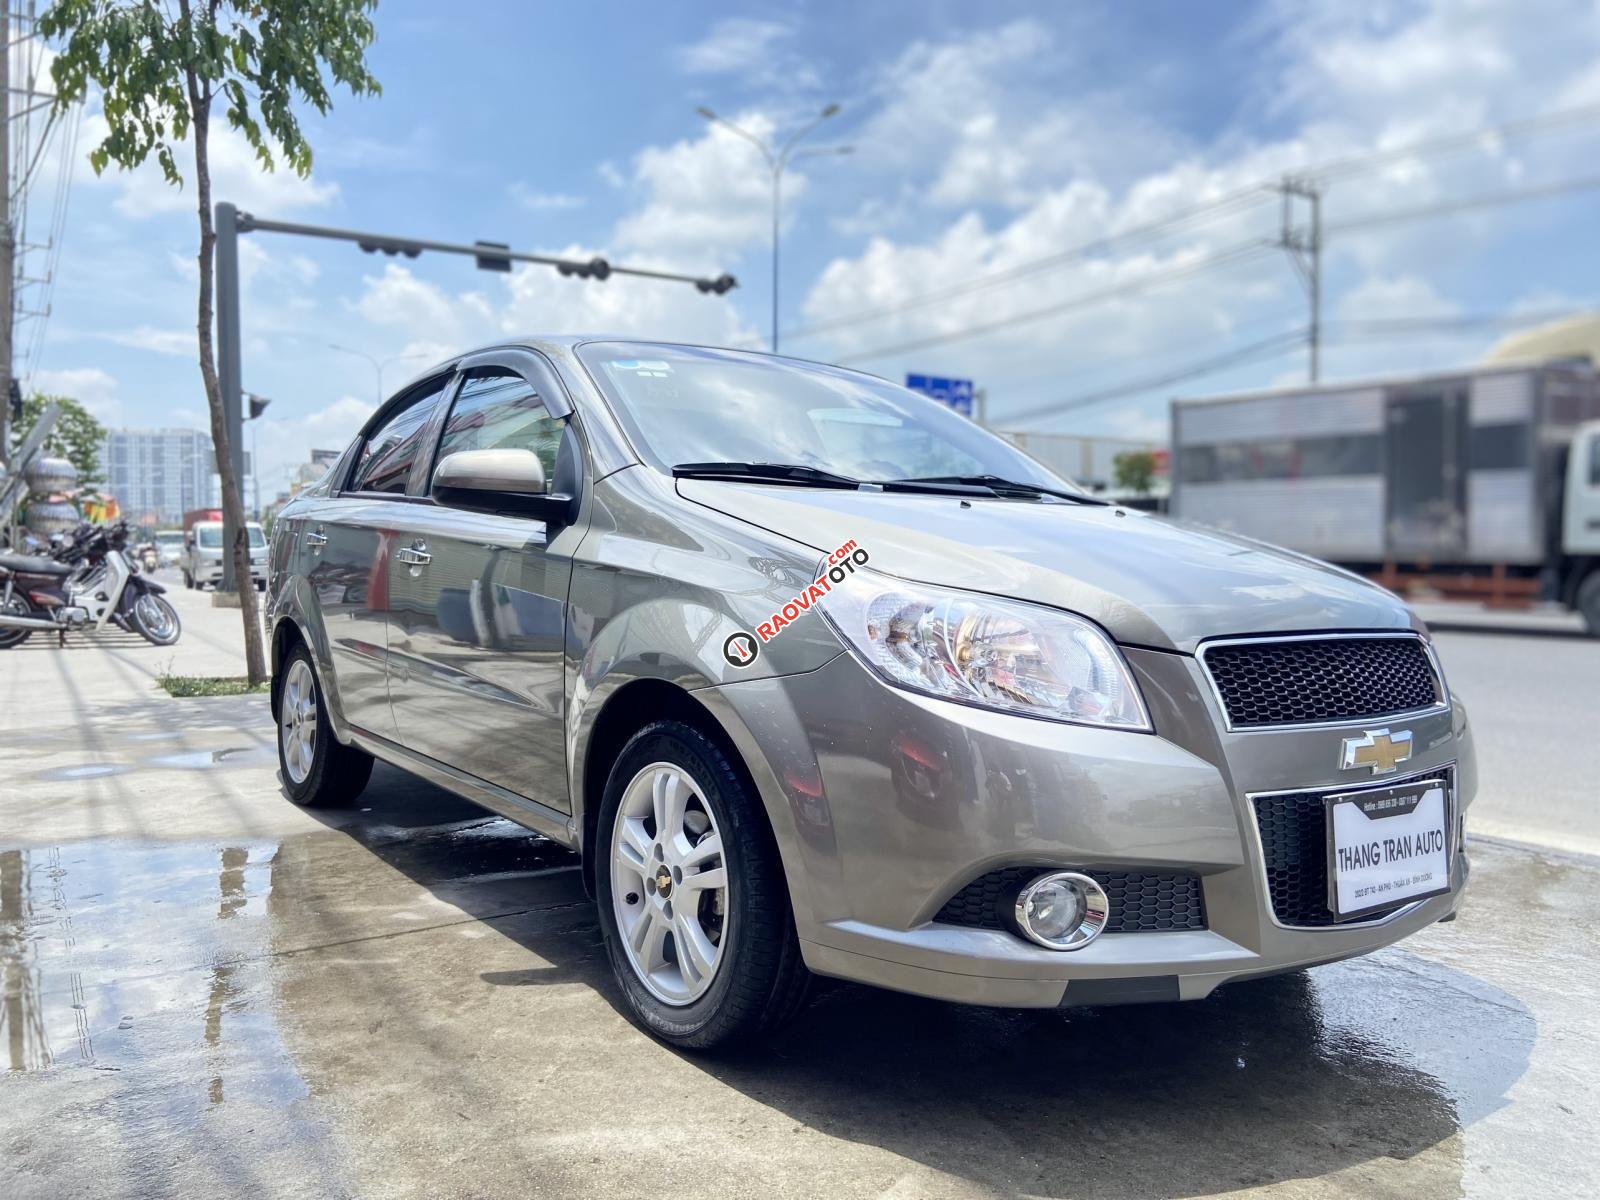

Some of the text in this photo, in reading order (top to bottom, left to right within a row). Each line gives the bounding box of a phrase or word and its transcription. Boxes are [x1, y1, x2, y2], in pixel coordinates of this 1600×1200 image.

[1338, 829, 1443, 872] THANG TRAN AUTO
